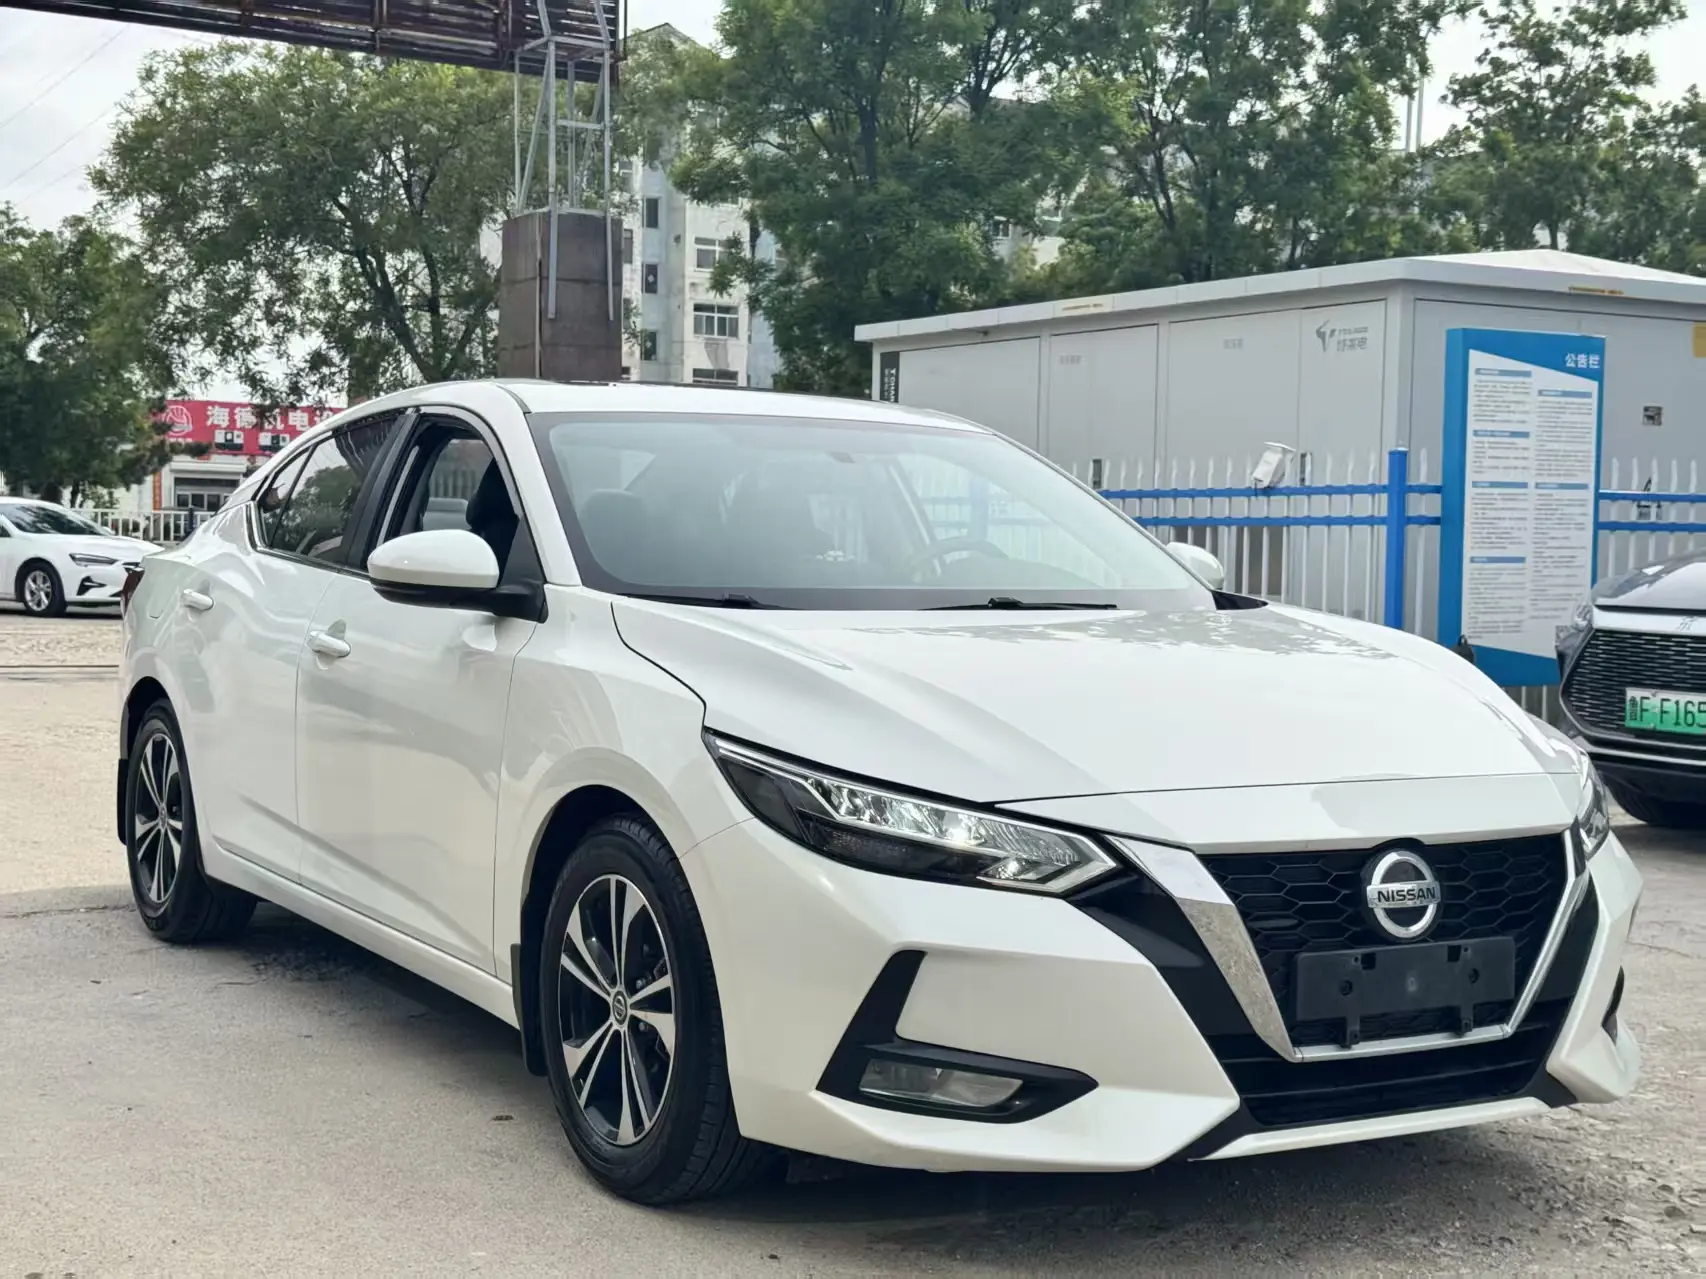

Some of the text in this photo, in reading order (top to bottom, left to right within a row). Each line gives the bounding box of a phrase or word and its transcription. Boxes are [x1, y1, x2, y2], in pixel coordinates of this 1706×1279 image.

[1565, 353, 1600, 368] 公告栏
[1377, 886, 1436, 902] NISSAN
